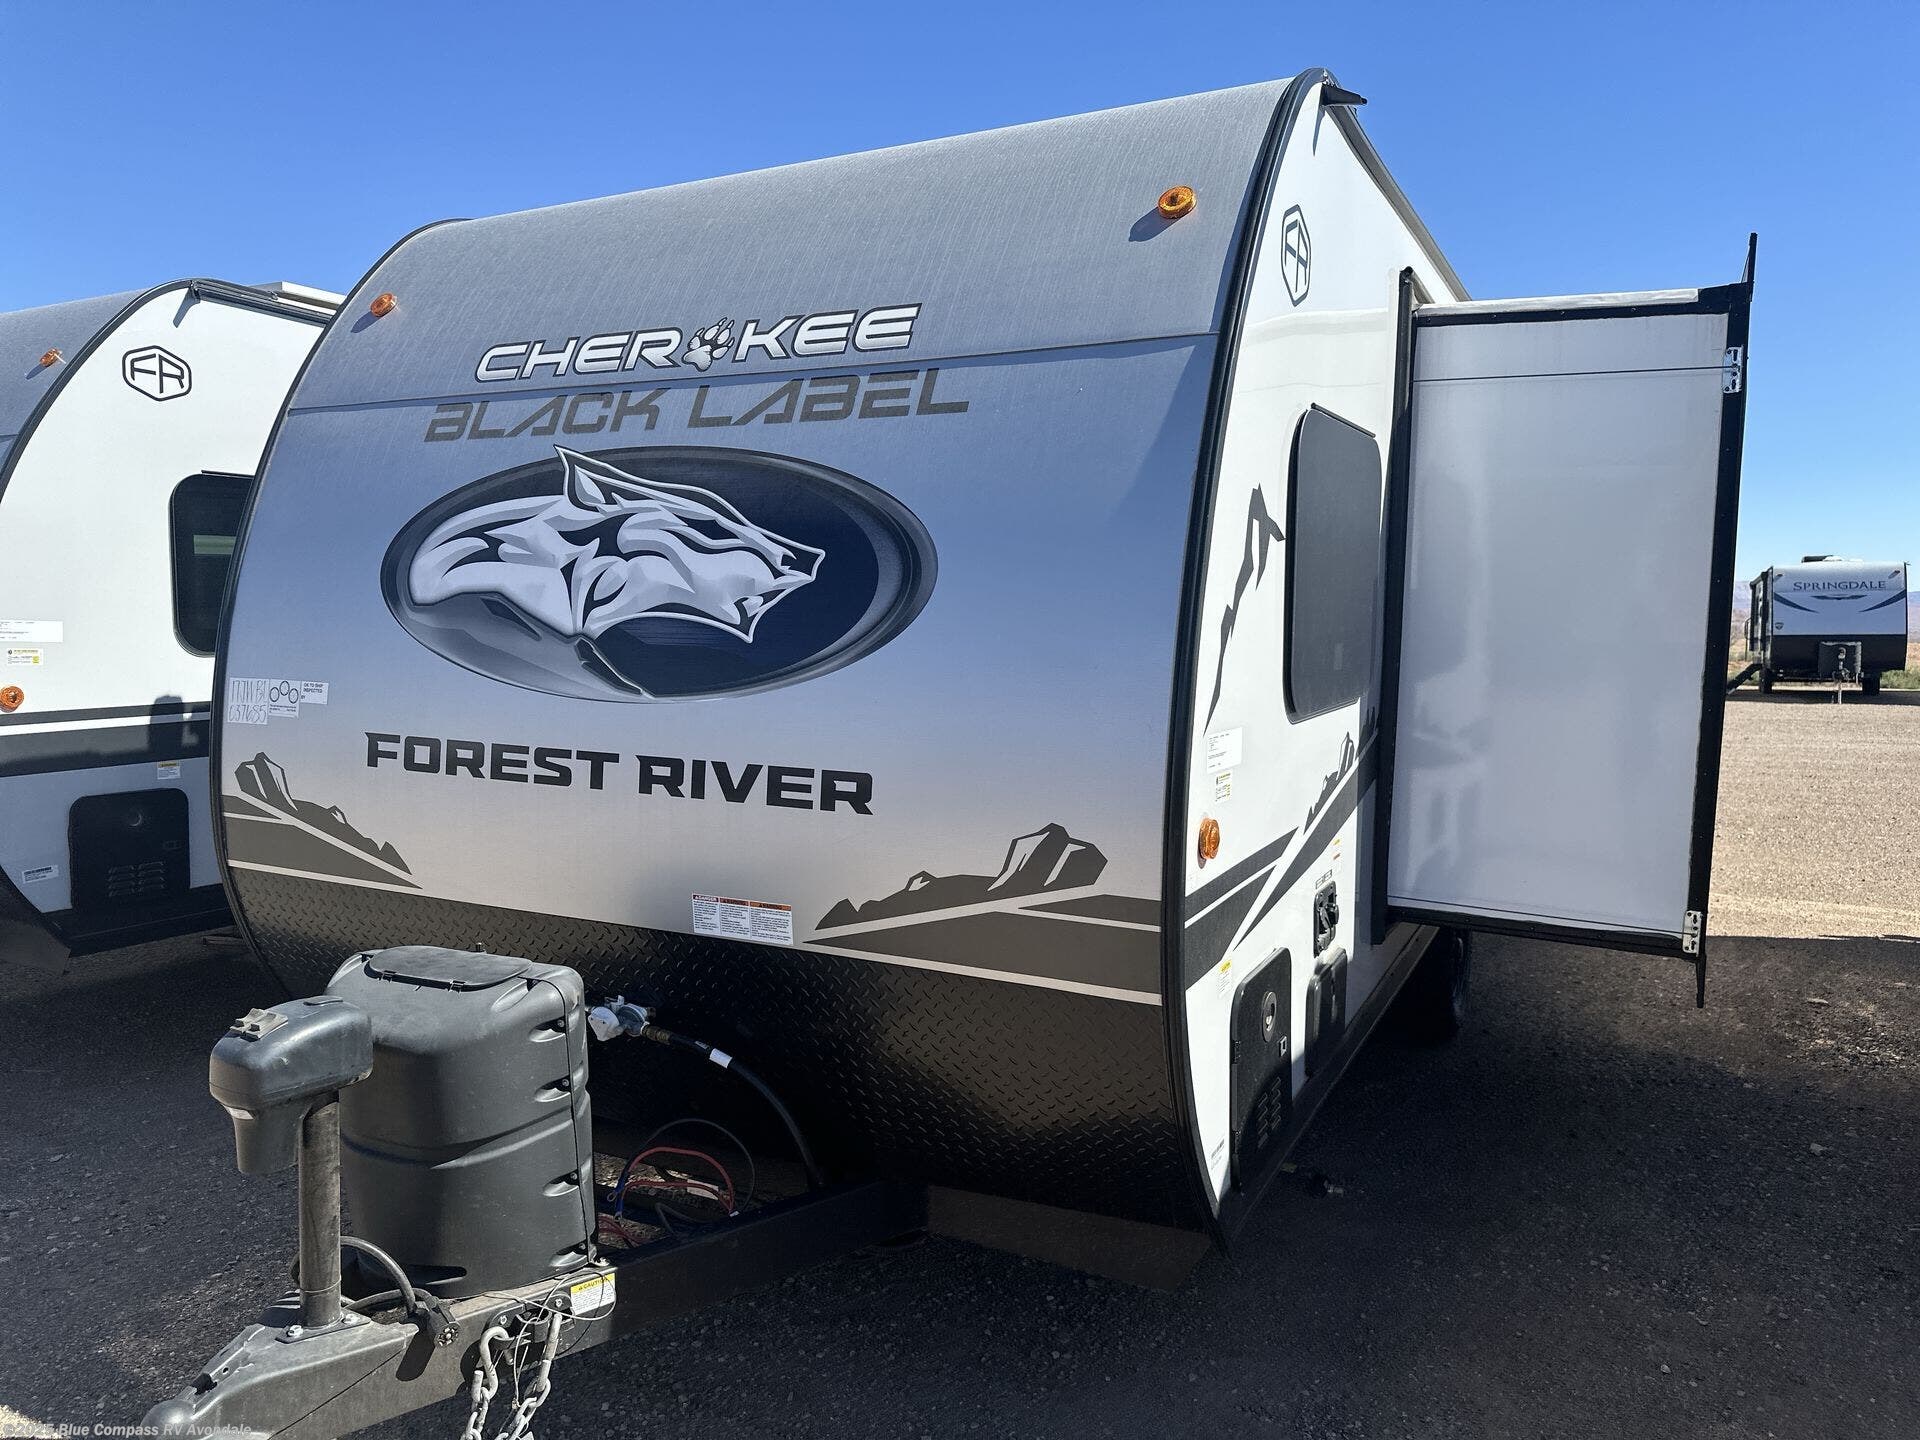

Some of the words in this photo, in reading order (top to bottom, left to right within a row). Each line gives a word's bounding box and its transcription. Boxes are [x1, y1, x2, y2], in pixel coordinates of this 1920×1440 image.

[423, 386, 670, 443] BLACK
[686, 367, 970, 429] LABEL
[1793, 580, 1887, 592] SPRINGDALE
[364, 731, 620, 791] FOREST
[634, 754, 874, 816] RIVER
